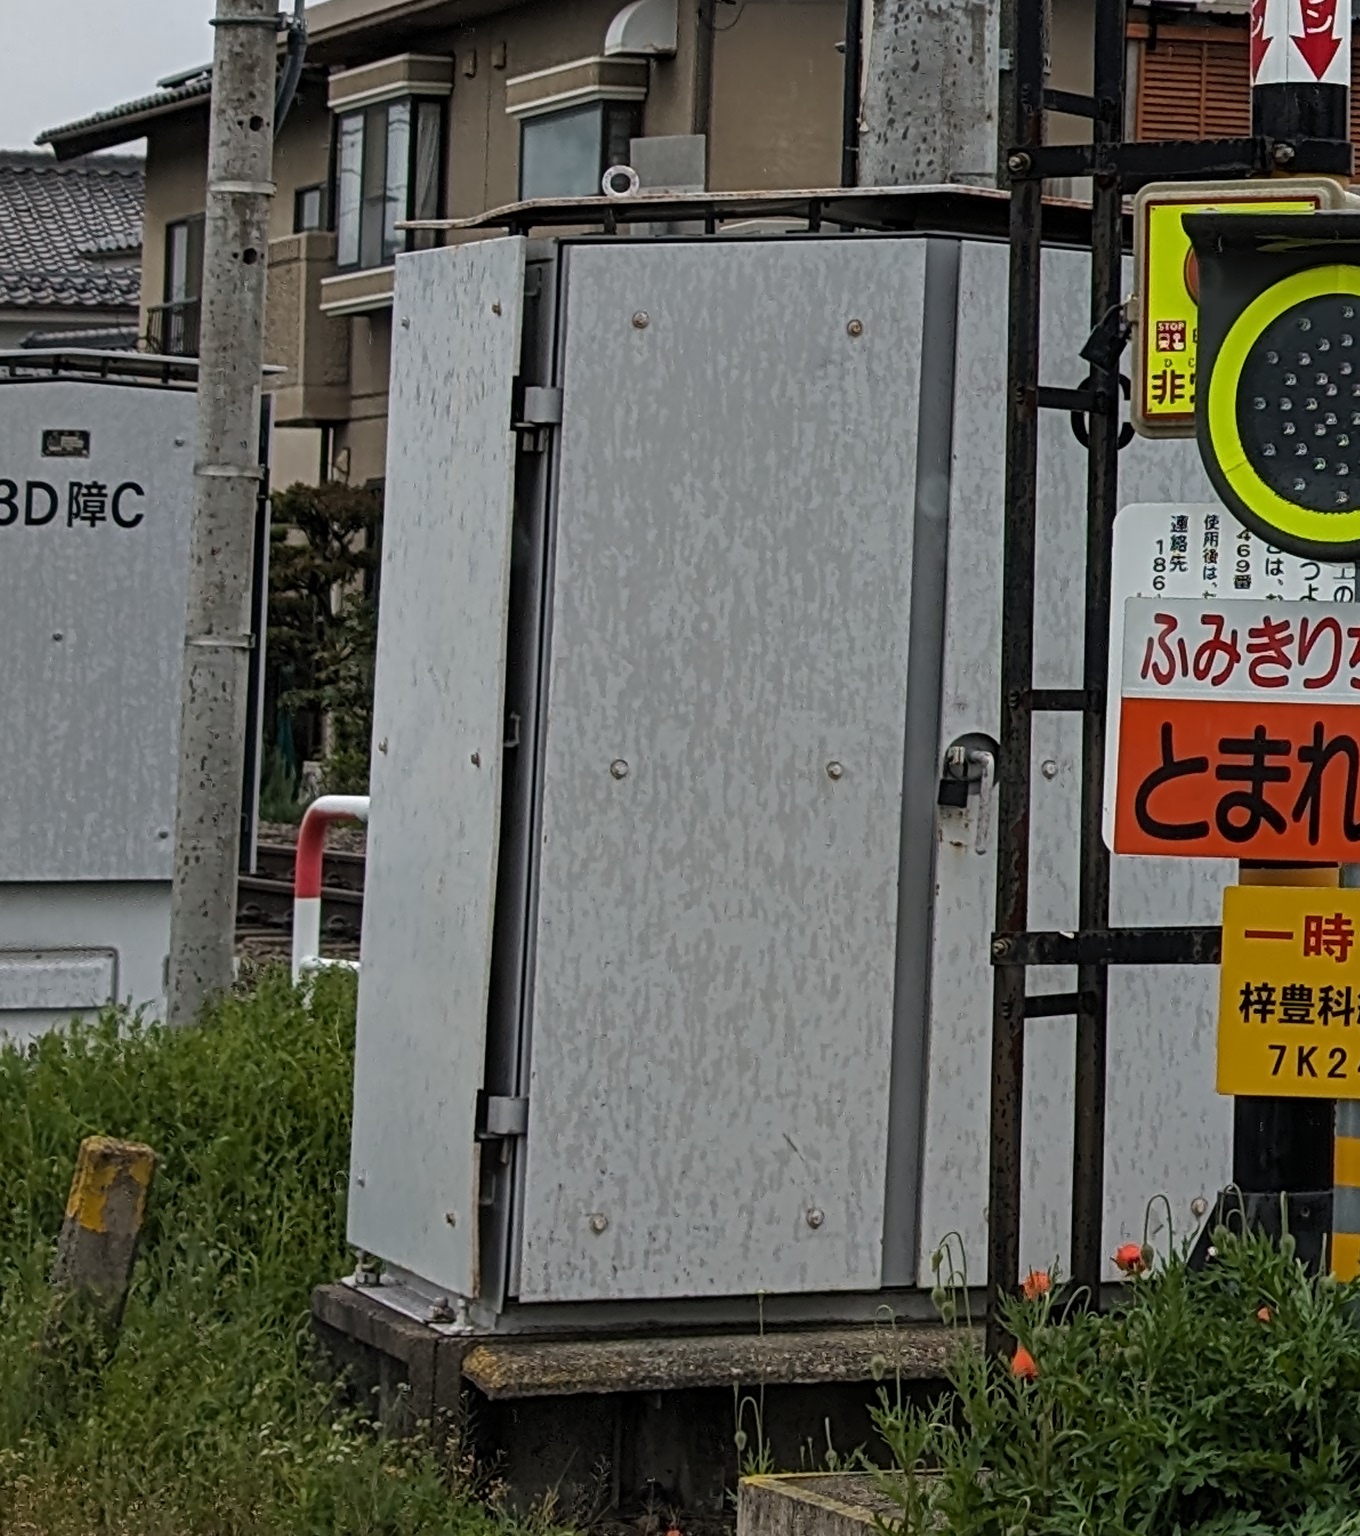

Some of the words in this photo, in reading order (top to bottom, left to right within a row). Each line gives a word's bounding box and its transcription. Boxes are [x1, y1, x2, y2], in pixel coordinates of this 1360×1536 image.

[1158, 322, 1185, 332] STOP
[1152, 369, 1196, 405] 非
[1169, 514, 1189, 572] 連絡先
